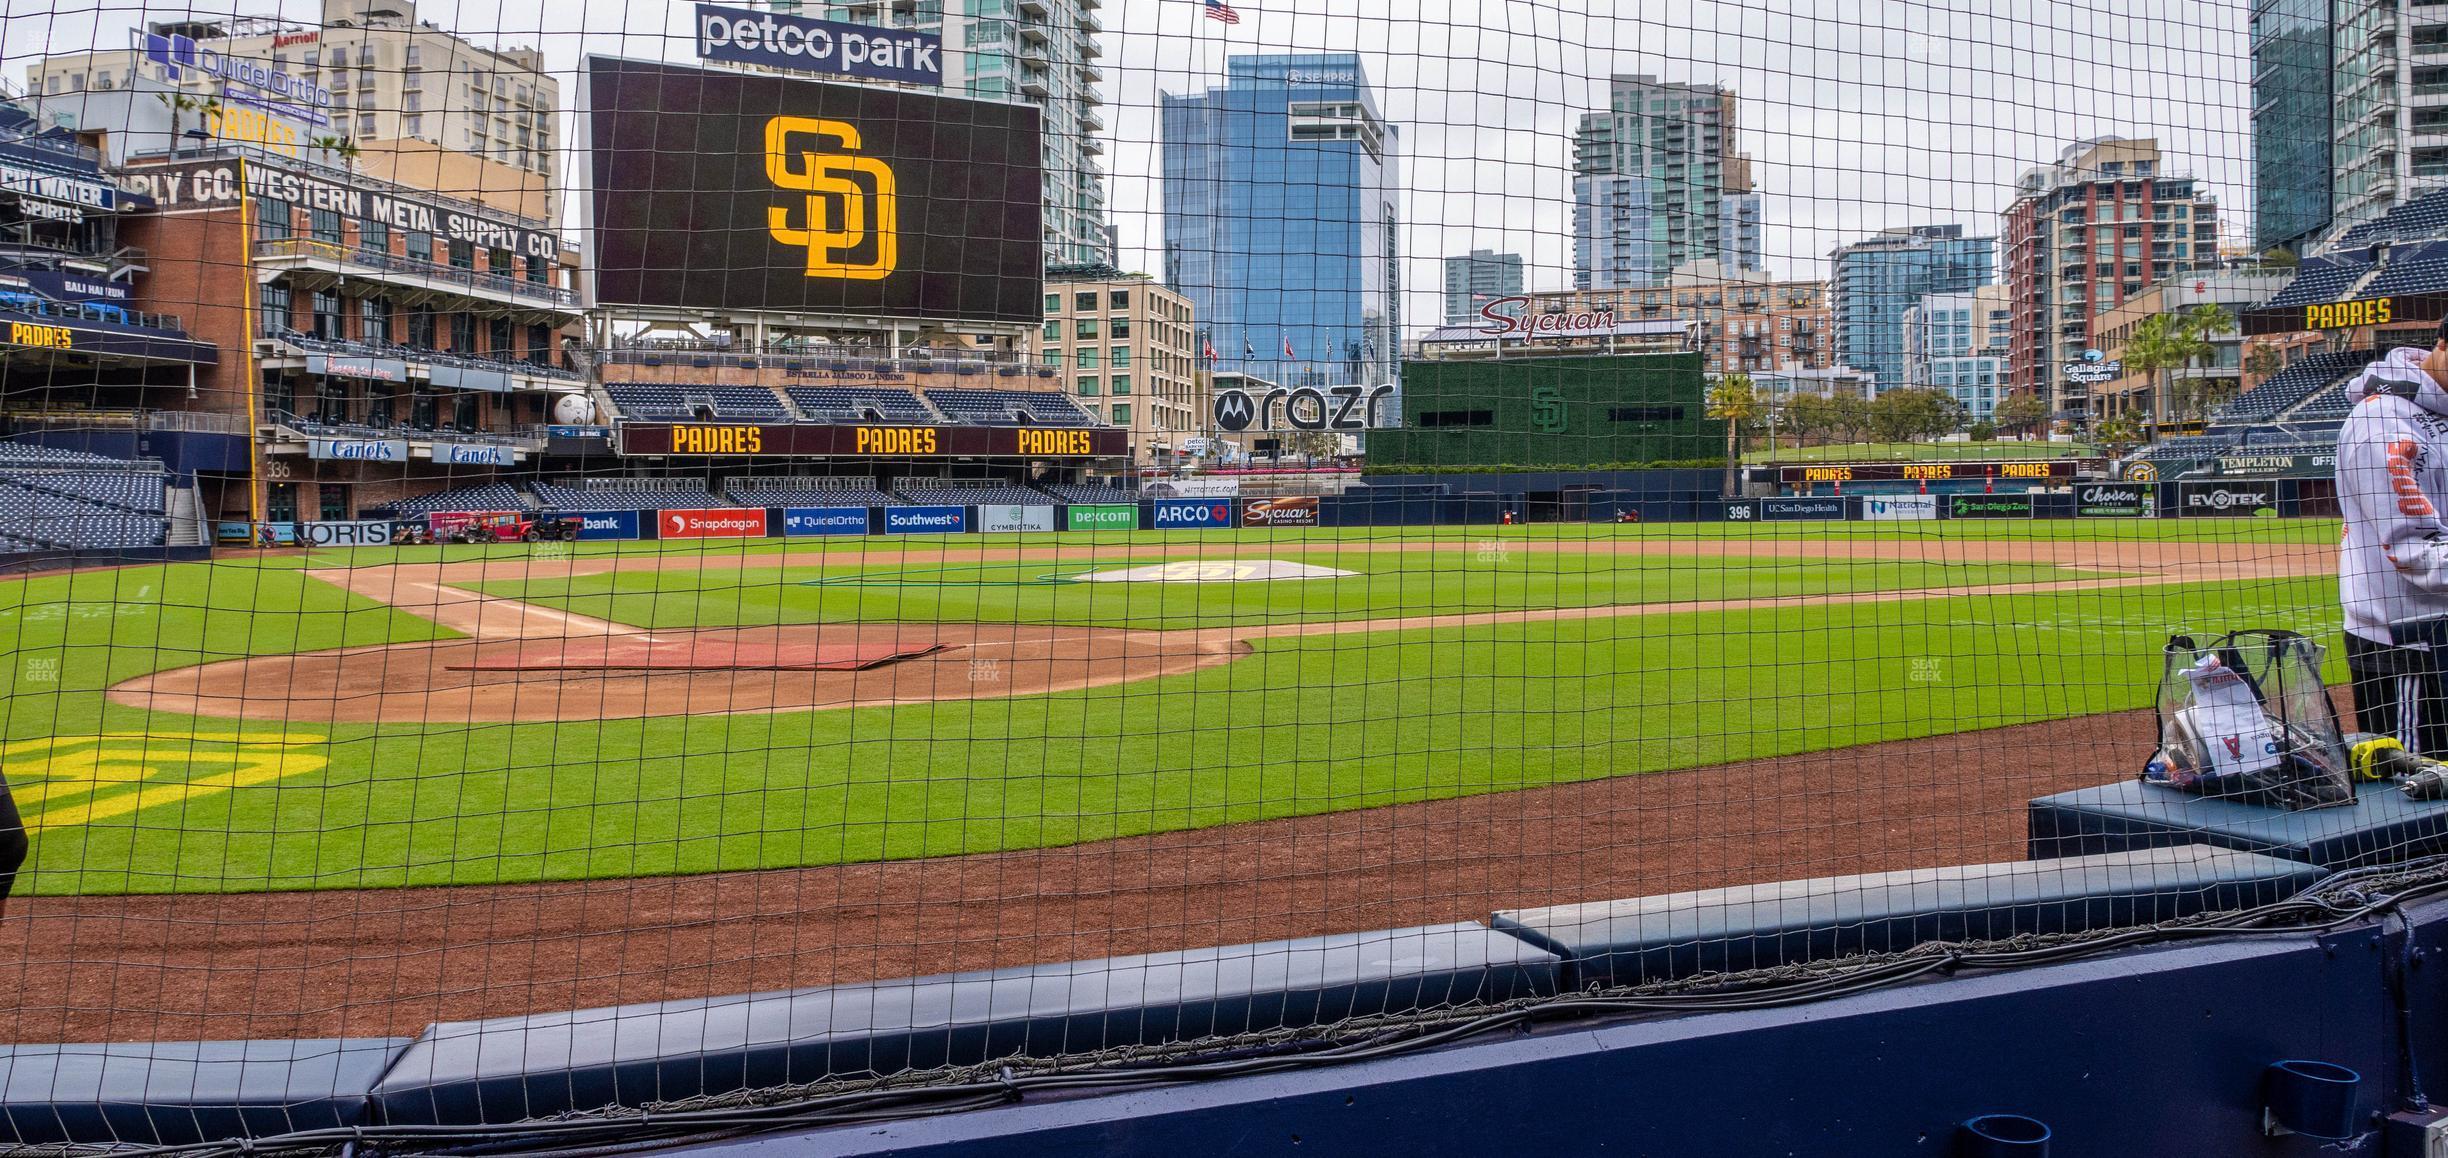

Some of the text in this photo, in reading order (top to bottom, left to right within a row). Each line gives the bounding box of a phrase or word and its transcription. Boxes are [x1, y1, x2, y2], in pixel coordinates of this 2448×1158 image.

[273, 31, 318, 48] Marriott
[702, 15, 938, 73] petco park
[201, 49, 330, 107] QuidelOrtho
[1305, 72, 1354, 83] SEMPRA
[20, 197, 83, 224] SPIRITS
[246, 165, 558, 260] WESTERN METAL SUPPLY CO.
[64, 280, 87, 294] BALI
[1480, 296, 1619, 344] Sycuan
[2306, 298, 2391, 329] PADRES
[11, 322, 72, 348] PADRES
[786, 370, 905, 381] ESTRELLA JALISCO LANDING
[2070, 372, 2112, 384] Square
[1260, 383, 1396, 432] razr
[673, 425, 761, 453] PADRES
[857, 427, 936, 454] PADRES
[1018, 429, 1091, 454] PADRES
[330, 440, 393, 460] Canel's
[450, 445, 501, 465] Canel's
[266, 461, 290, 478] 336
[1903, 464, 1951, 479] PADRES
[2001, 463, 2050, 477] PADRES
[2219, 456, 2293, 470] TEMPLETON
[1805, 467, 1852, 481] PADRES
[2083, 486, 2136, 503] Chosen
[2188, 490, 2266, 509] EVOTEK
[1247, 501, 1311, 524] Sycuan
[1729, 506, 1750, 518] 396
[1780, 504, 1798, 512] San
[1798, 504, 1814, 513] Diego
[1814, 504, 1838, 512] Health
[1889, 499, 1932, 509] National
[2011, 502, 2029, 510] Zoo
[584, 517, 618, 529] bank
[804, 516, 865, 526] QuidelOrtho
[890, 514, 952, 525] Southwest
[1157, 507, 1209, 522] ARCO
[690, 518, 759, 530] Snapdragon
[311, 524, 389, 544] ORIS
